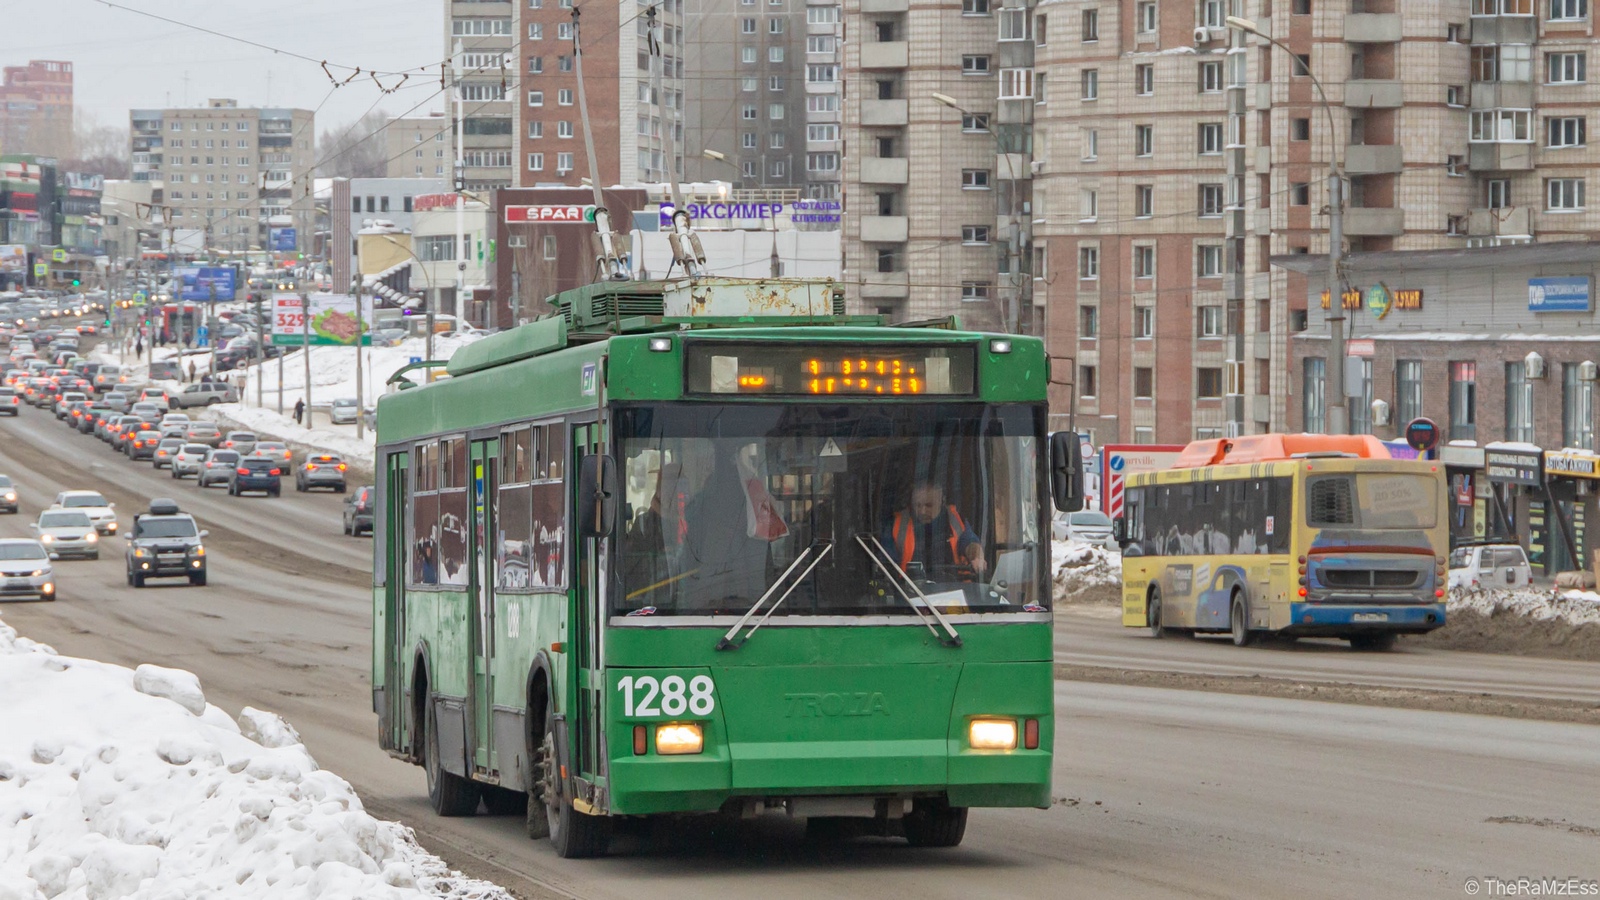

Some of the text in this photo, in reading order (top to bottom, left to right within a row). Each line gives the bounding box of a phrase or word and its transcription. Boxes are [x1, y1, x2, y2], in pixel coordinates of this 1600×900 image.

[526, 207, 579, 220] SPAR
[686, 203, 783, 219] ЭКСИМЕР
[617, 675, 715, 718] 1288
